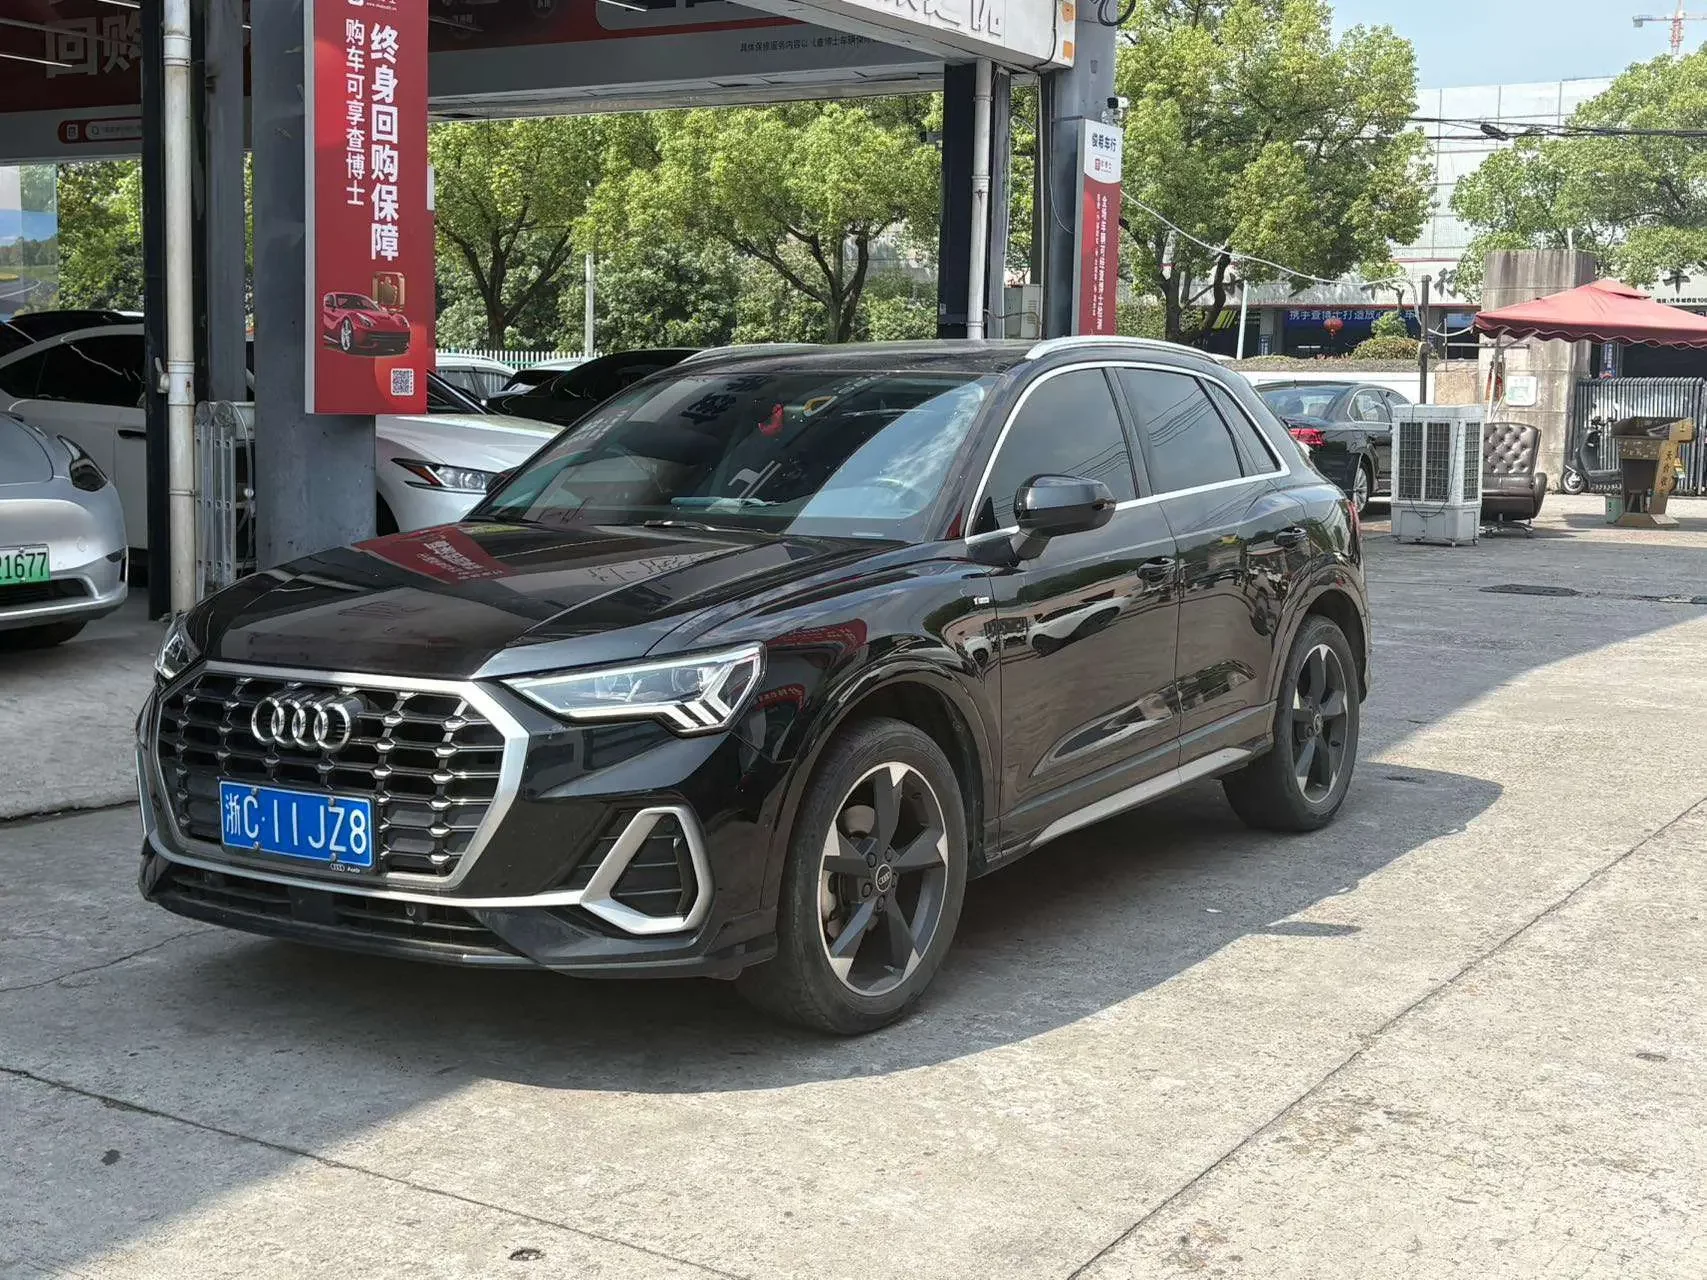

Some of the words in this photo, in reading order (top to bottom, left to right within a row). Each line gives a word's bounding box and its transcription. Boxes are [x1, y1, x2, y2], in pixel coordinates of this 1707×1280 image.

[345, 18, 365, 206] 购车可享查博士
[370, 23, 399, 261] 终身回购保障
[0, 552, 47, 579] 1677
